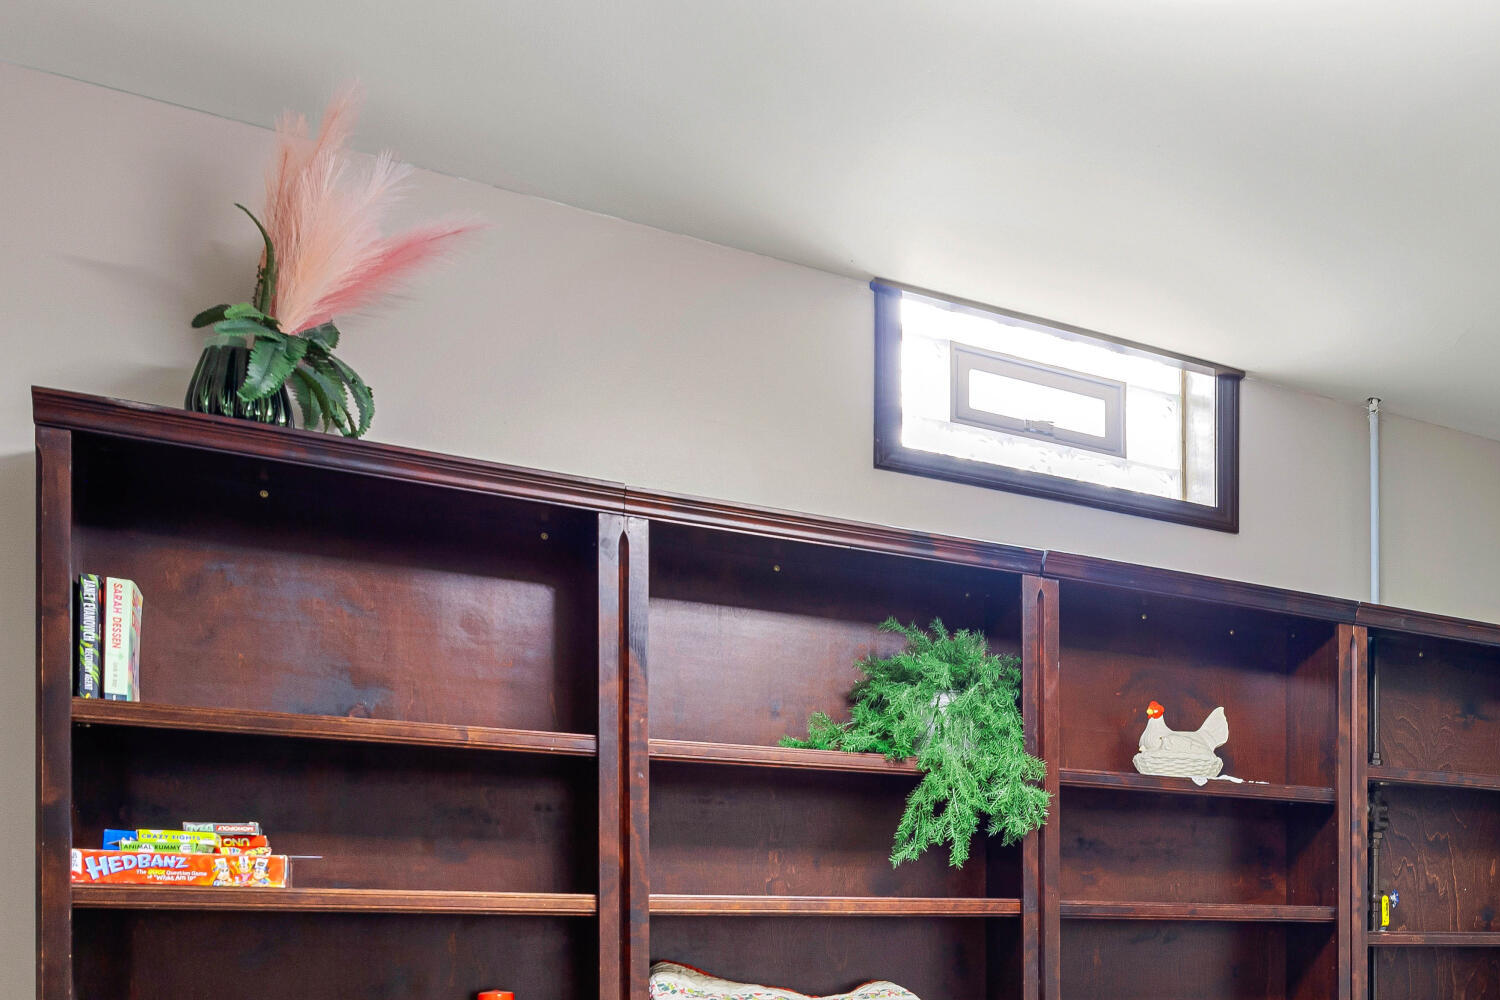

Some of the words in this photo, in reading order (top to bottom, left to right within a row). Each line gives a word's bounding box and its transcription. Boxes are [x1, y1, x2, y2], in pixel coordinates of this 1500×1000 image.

[83, 579, 96, 601] JANET
[113, 583, 122, 613] SARAH
[83, 602, 96, 641] EVANOVICH
[112, 616, 122, 649] DESSEN
[217, 825, 255, 833] MONOPOLY
[223, 837, 250, 847] UNO
[84, 853, 189, 880] HEDBANZ
